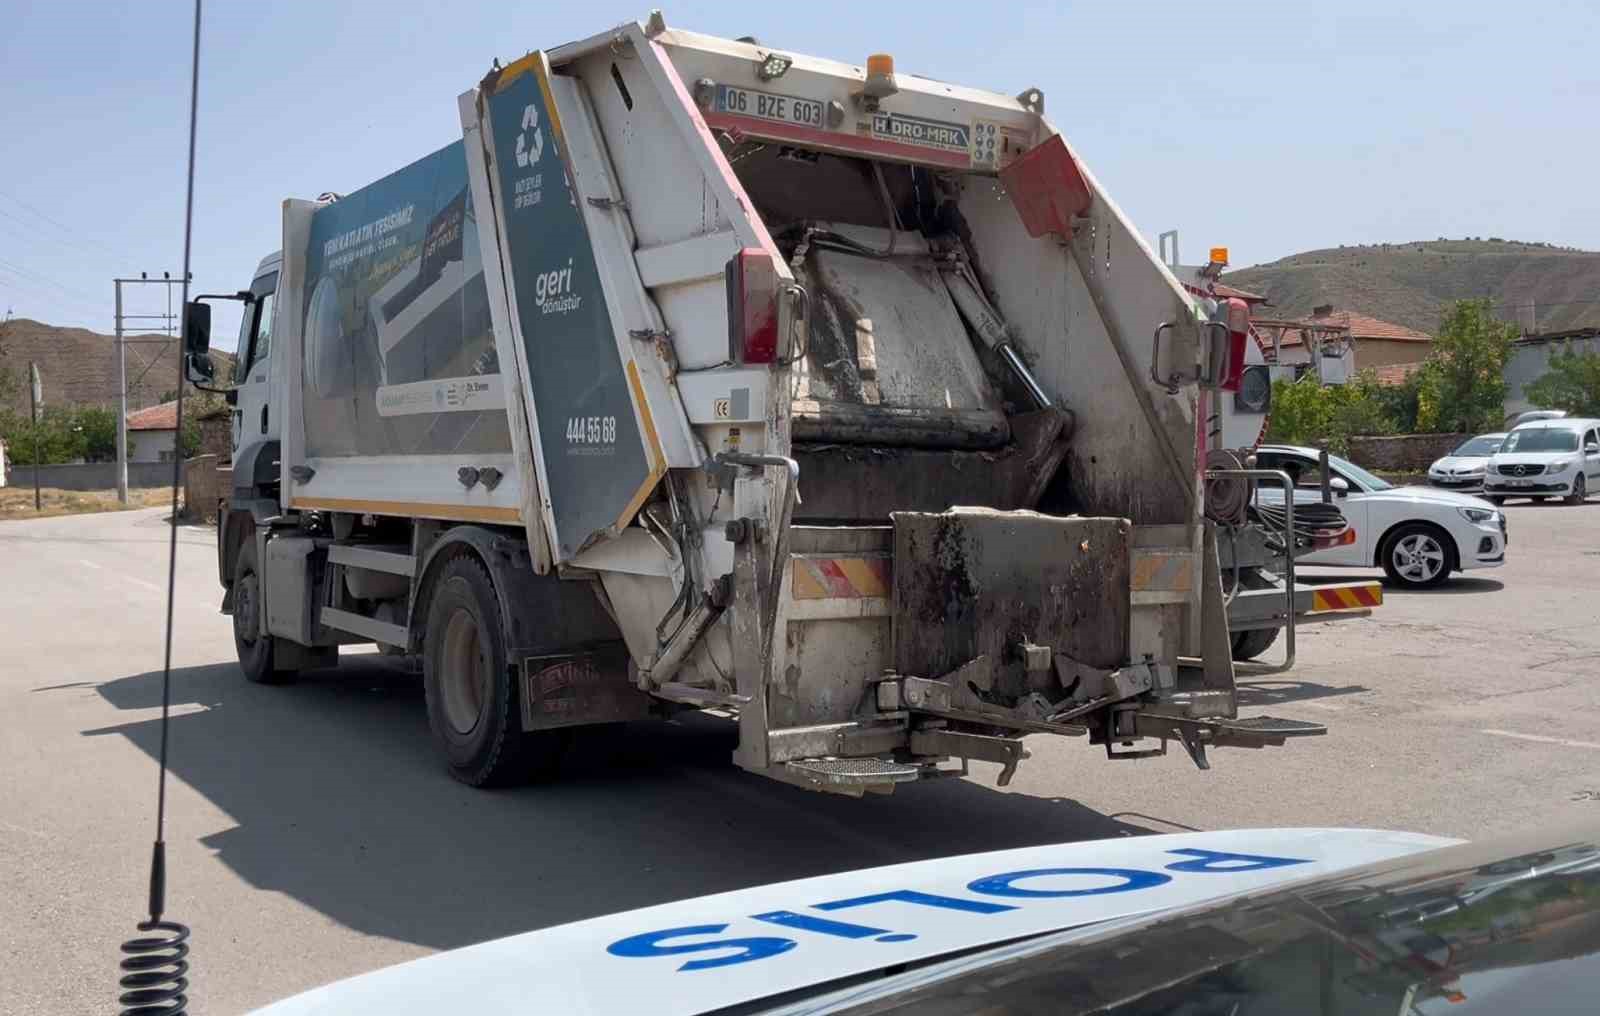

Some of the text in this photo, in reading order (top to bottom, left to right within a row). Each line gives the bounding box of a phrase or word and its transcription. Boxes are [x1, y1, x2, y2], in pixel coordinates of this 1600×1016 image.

[728, 90, 746, 111] 06
[758, 95, 785, 118] BZE
[793, 101, 820, 123] 603
[874, 117, 959, 145] HDRO-MAK
[536, 257, 573, 306] geri
[543, 293, 582, 315] dönüştür
[567, 416, 616, 443] 444 55 68
